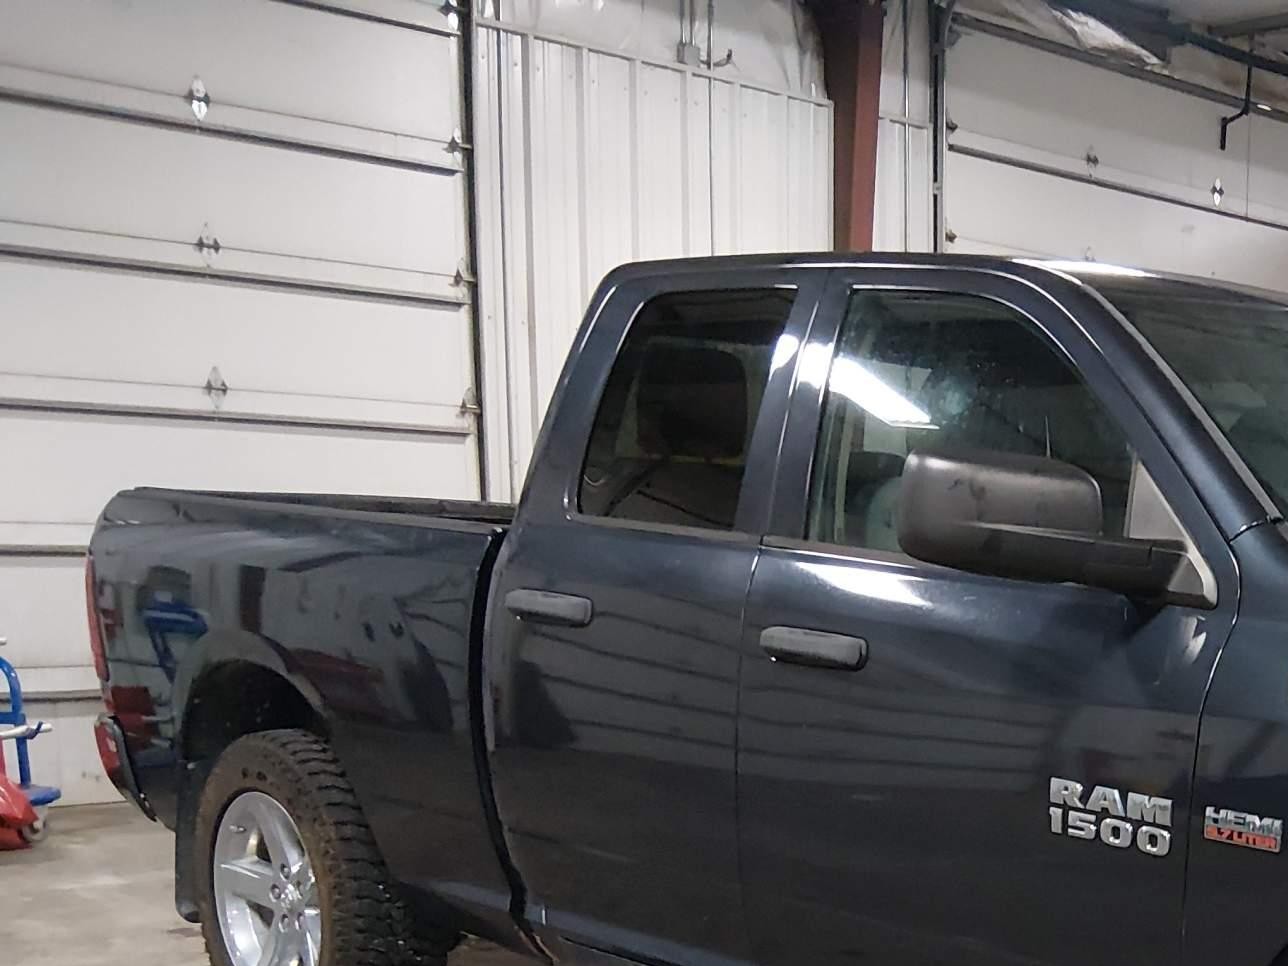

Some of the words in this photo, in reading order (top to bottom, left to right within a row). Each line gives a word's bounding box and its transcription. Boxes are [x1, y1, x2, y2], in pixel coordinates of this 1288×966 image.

[1049, 776, 1173, 827] RAM
[1205, 806, 1283, 835] HEMI
[1049, 806, 1171, 856] 1500
